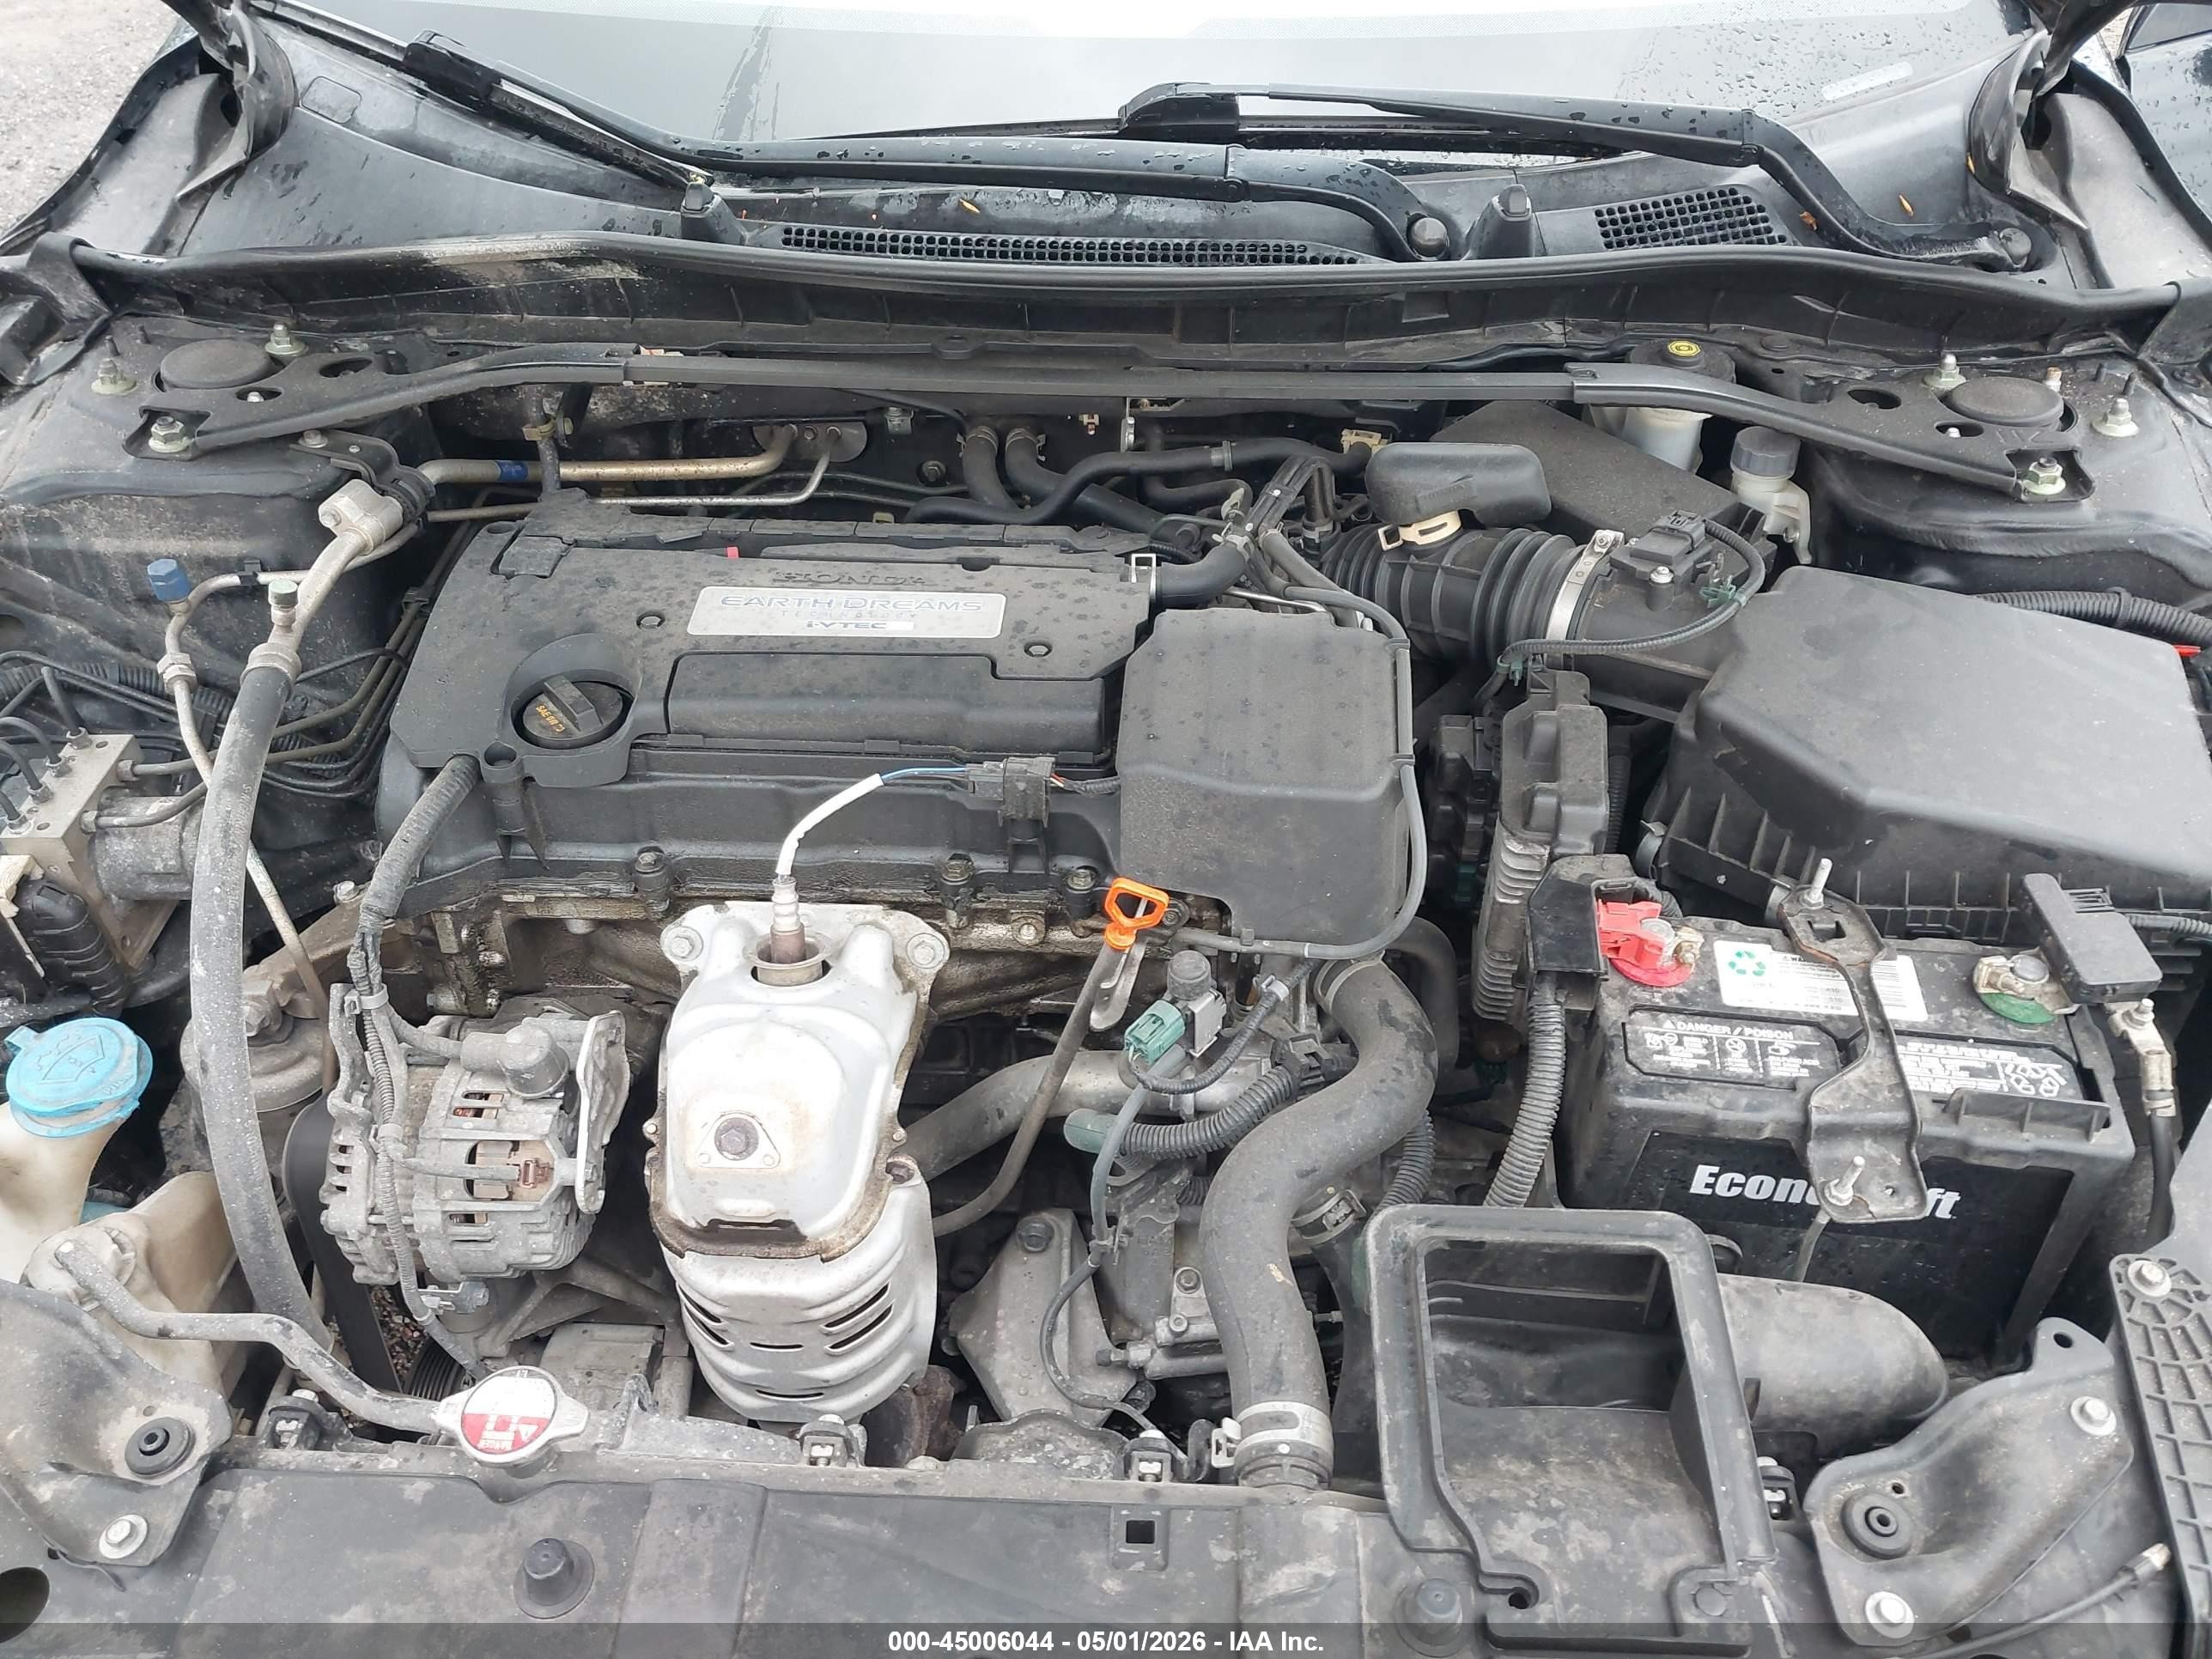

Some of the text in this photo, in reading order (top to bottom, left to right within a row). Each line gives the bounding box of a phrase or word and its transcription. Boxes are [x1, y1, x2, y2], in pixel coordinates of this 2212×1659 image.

[771, 572, 933, 586] HONDA
[720, 595, 984, 612] EARTH DREAMS
[806, 621, 888, 629] i-VTEC
[1677, 1021, 1732, 1035] DANGER
[1744, 1027, 1794, 1040] POISON
